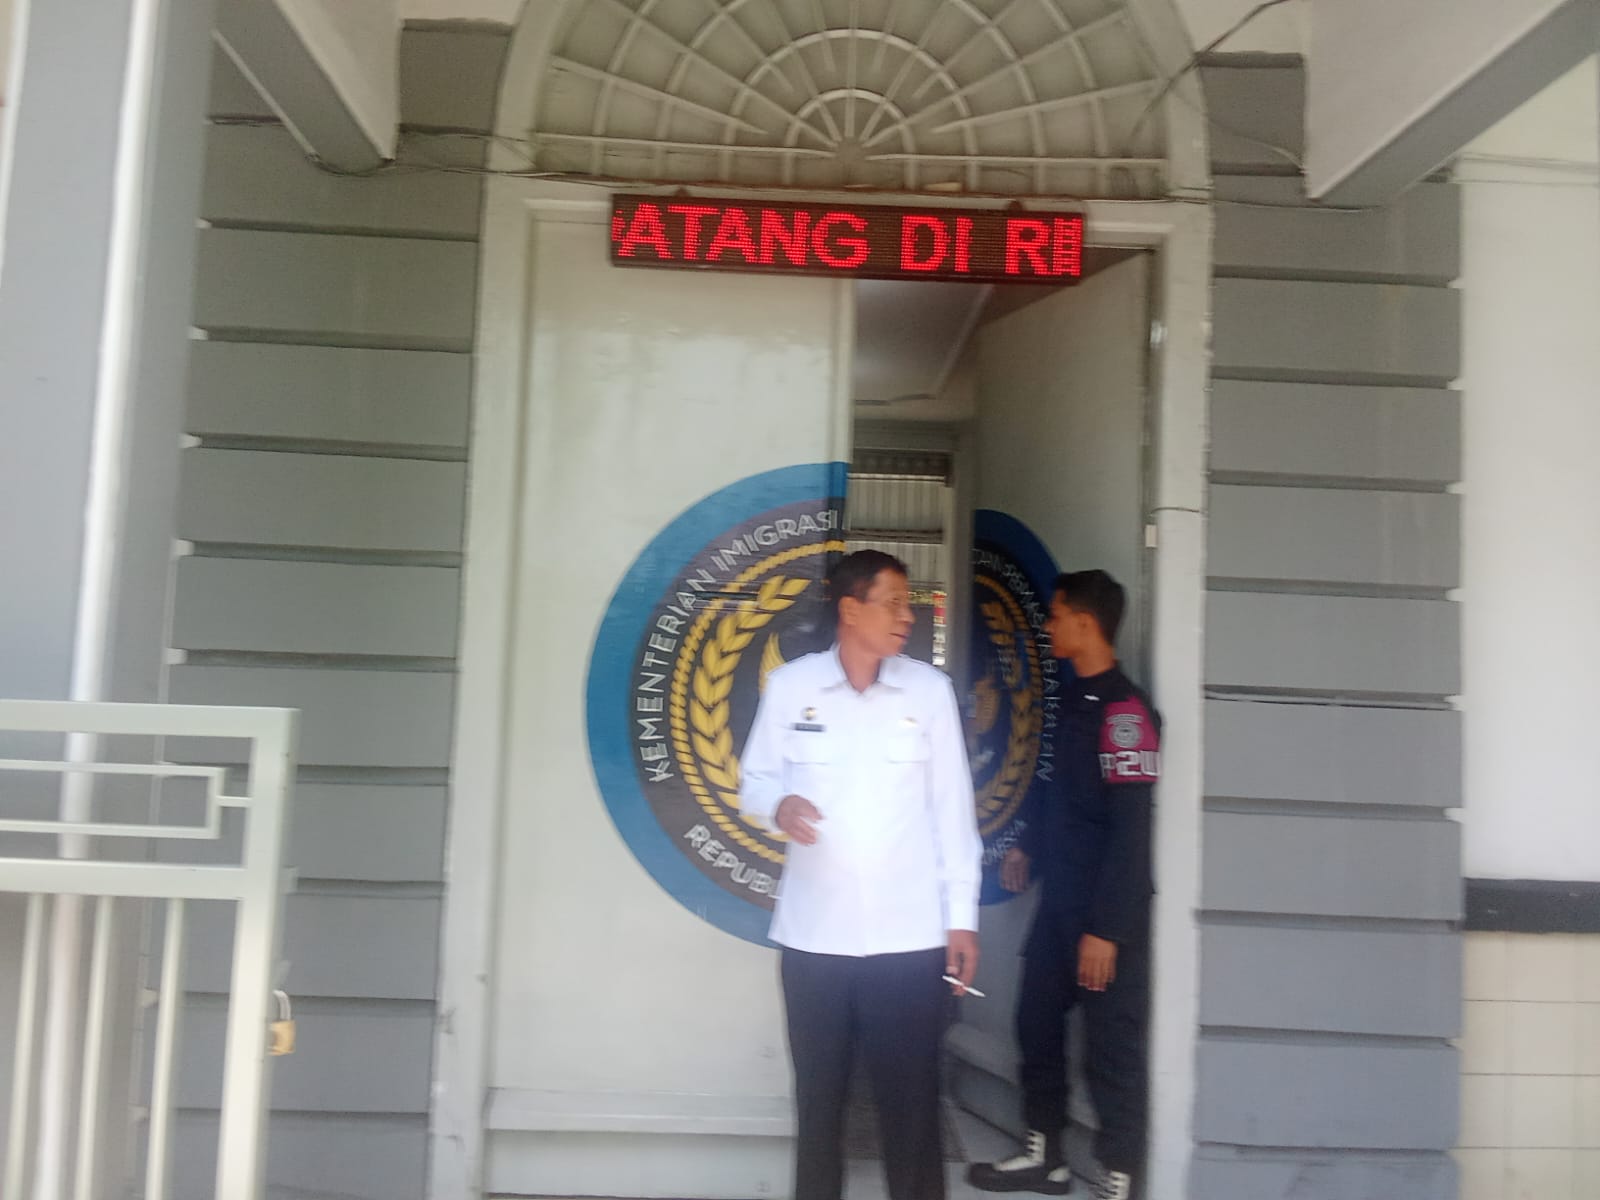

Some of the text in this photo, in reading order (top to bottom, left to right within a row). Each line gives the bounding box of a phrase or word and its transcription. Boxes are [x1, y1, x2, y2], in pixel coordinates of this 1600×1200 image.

[611, 203, 871, 269] ATANG
[901, 215, 973, 272] DI
[637, 509, 838, 782] KEMENTERIAN IMIGRASI
[683, 824, 782, 900] REPUBL
